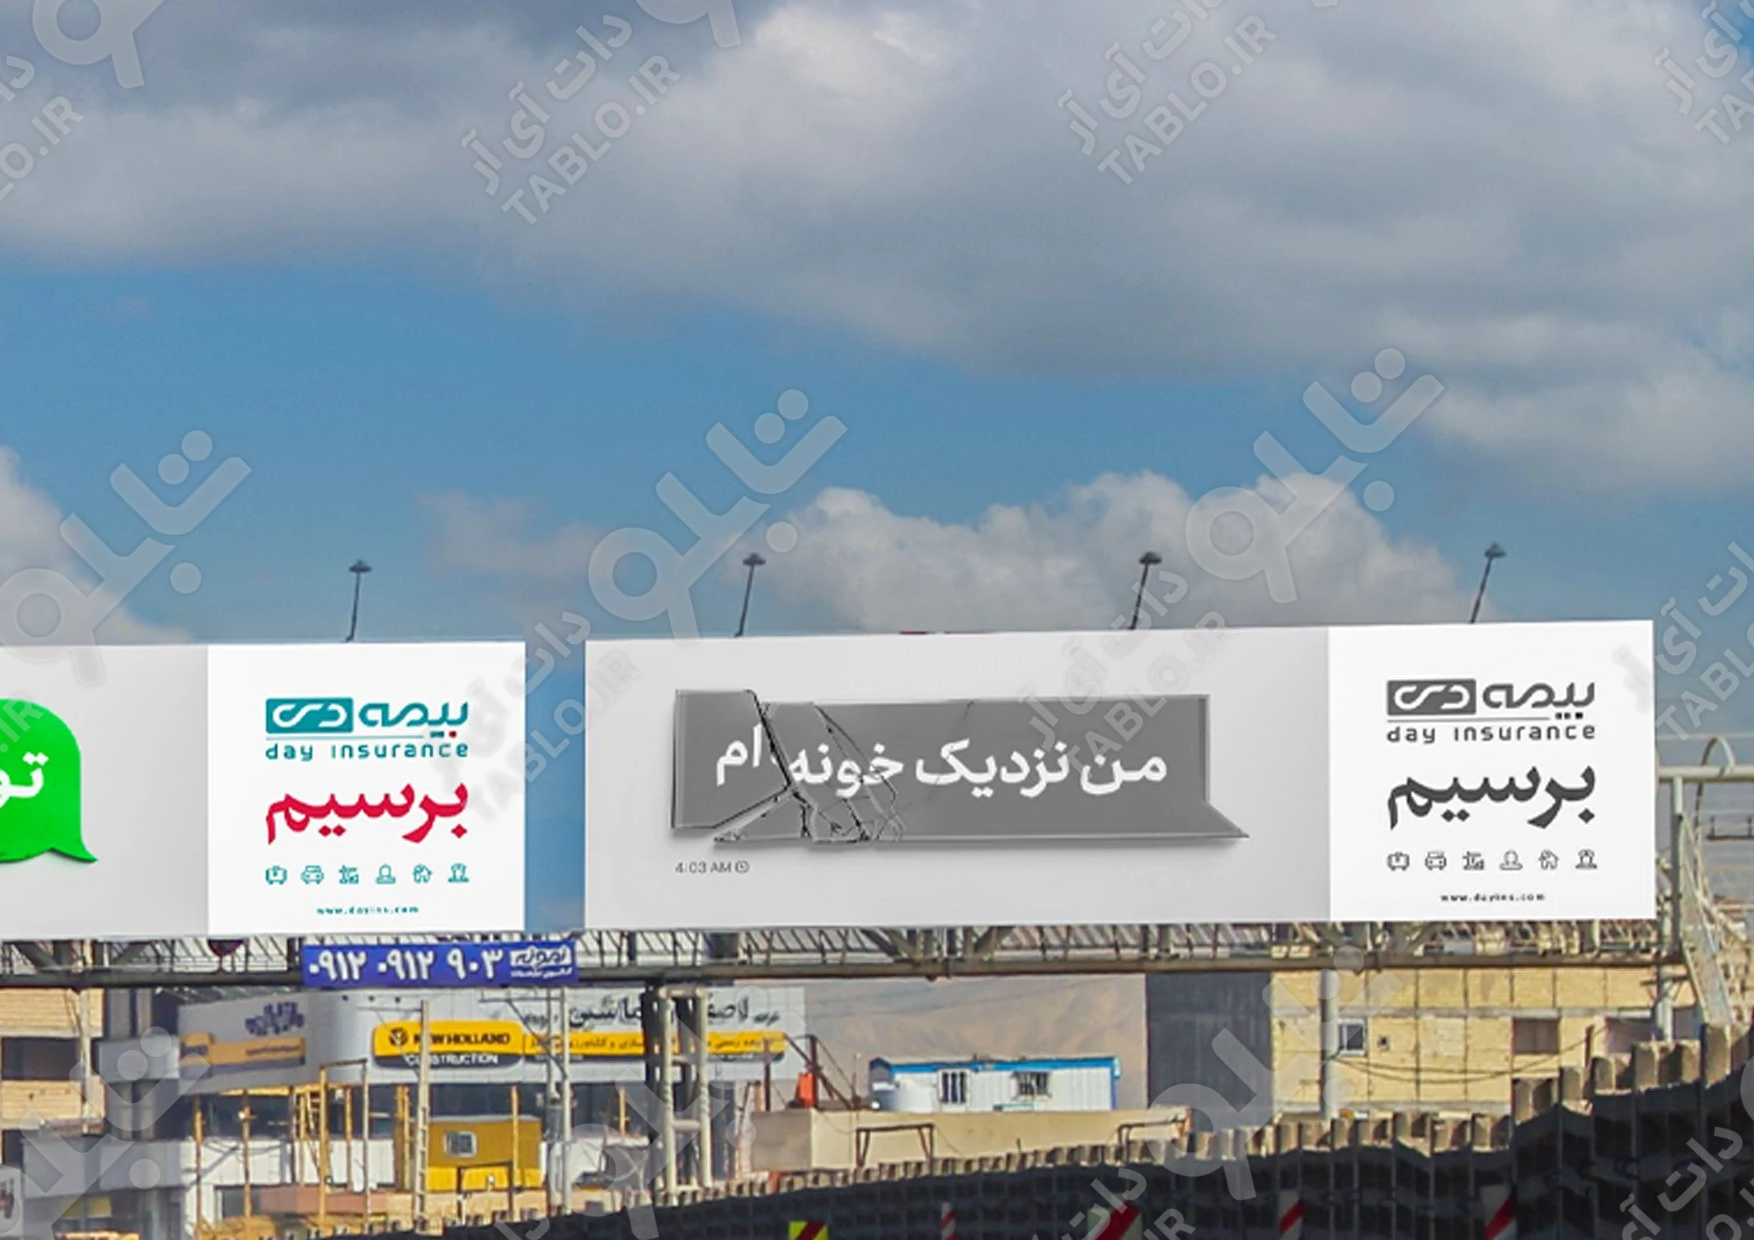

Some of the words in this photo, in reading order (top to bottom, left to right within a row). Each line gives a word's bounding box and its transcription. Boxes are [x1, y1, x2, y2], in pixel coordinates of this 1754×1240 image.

[1482, 681, 1596, 719] بیمه
[358, 701, 469, 739] بیمه
[1386, 726, 1436, 744] day
[1454, 724, 1596, 741] insurance
[265, 743, 314, 762] day
[331, 742, 469, 759] insurance
[716, 723, 763, 785] ام
[788, 742, 905, 798] خونه
[915, 739, 1069, 798] نزدیک
[1080, 752, 1167, 796] من
[265, 782, 469, 845] برسیم
[1387, 765, 1596, 830] برسیم
[675, 860, 707, 874] 4:03
[710, 860, 733, 874] AM
[309, 949, 367, 981] ۰۹۱۲
[377, 948, 436, 980] ۰۹۱۲
[447, 947, 503, 980] ۹۰۳
[413, 1033, 444, 1045] NW
[404, 1053, 499, 1066] CSTRUCTION
